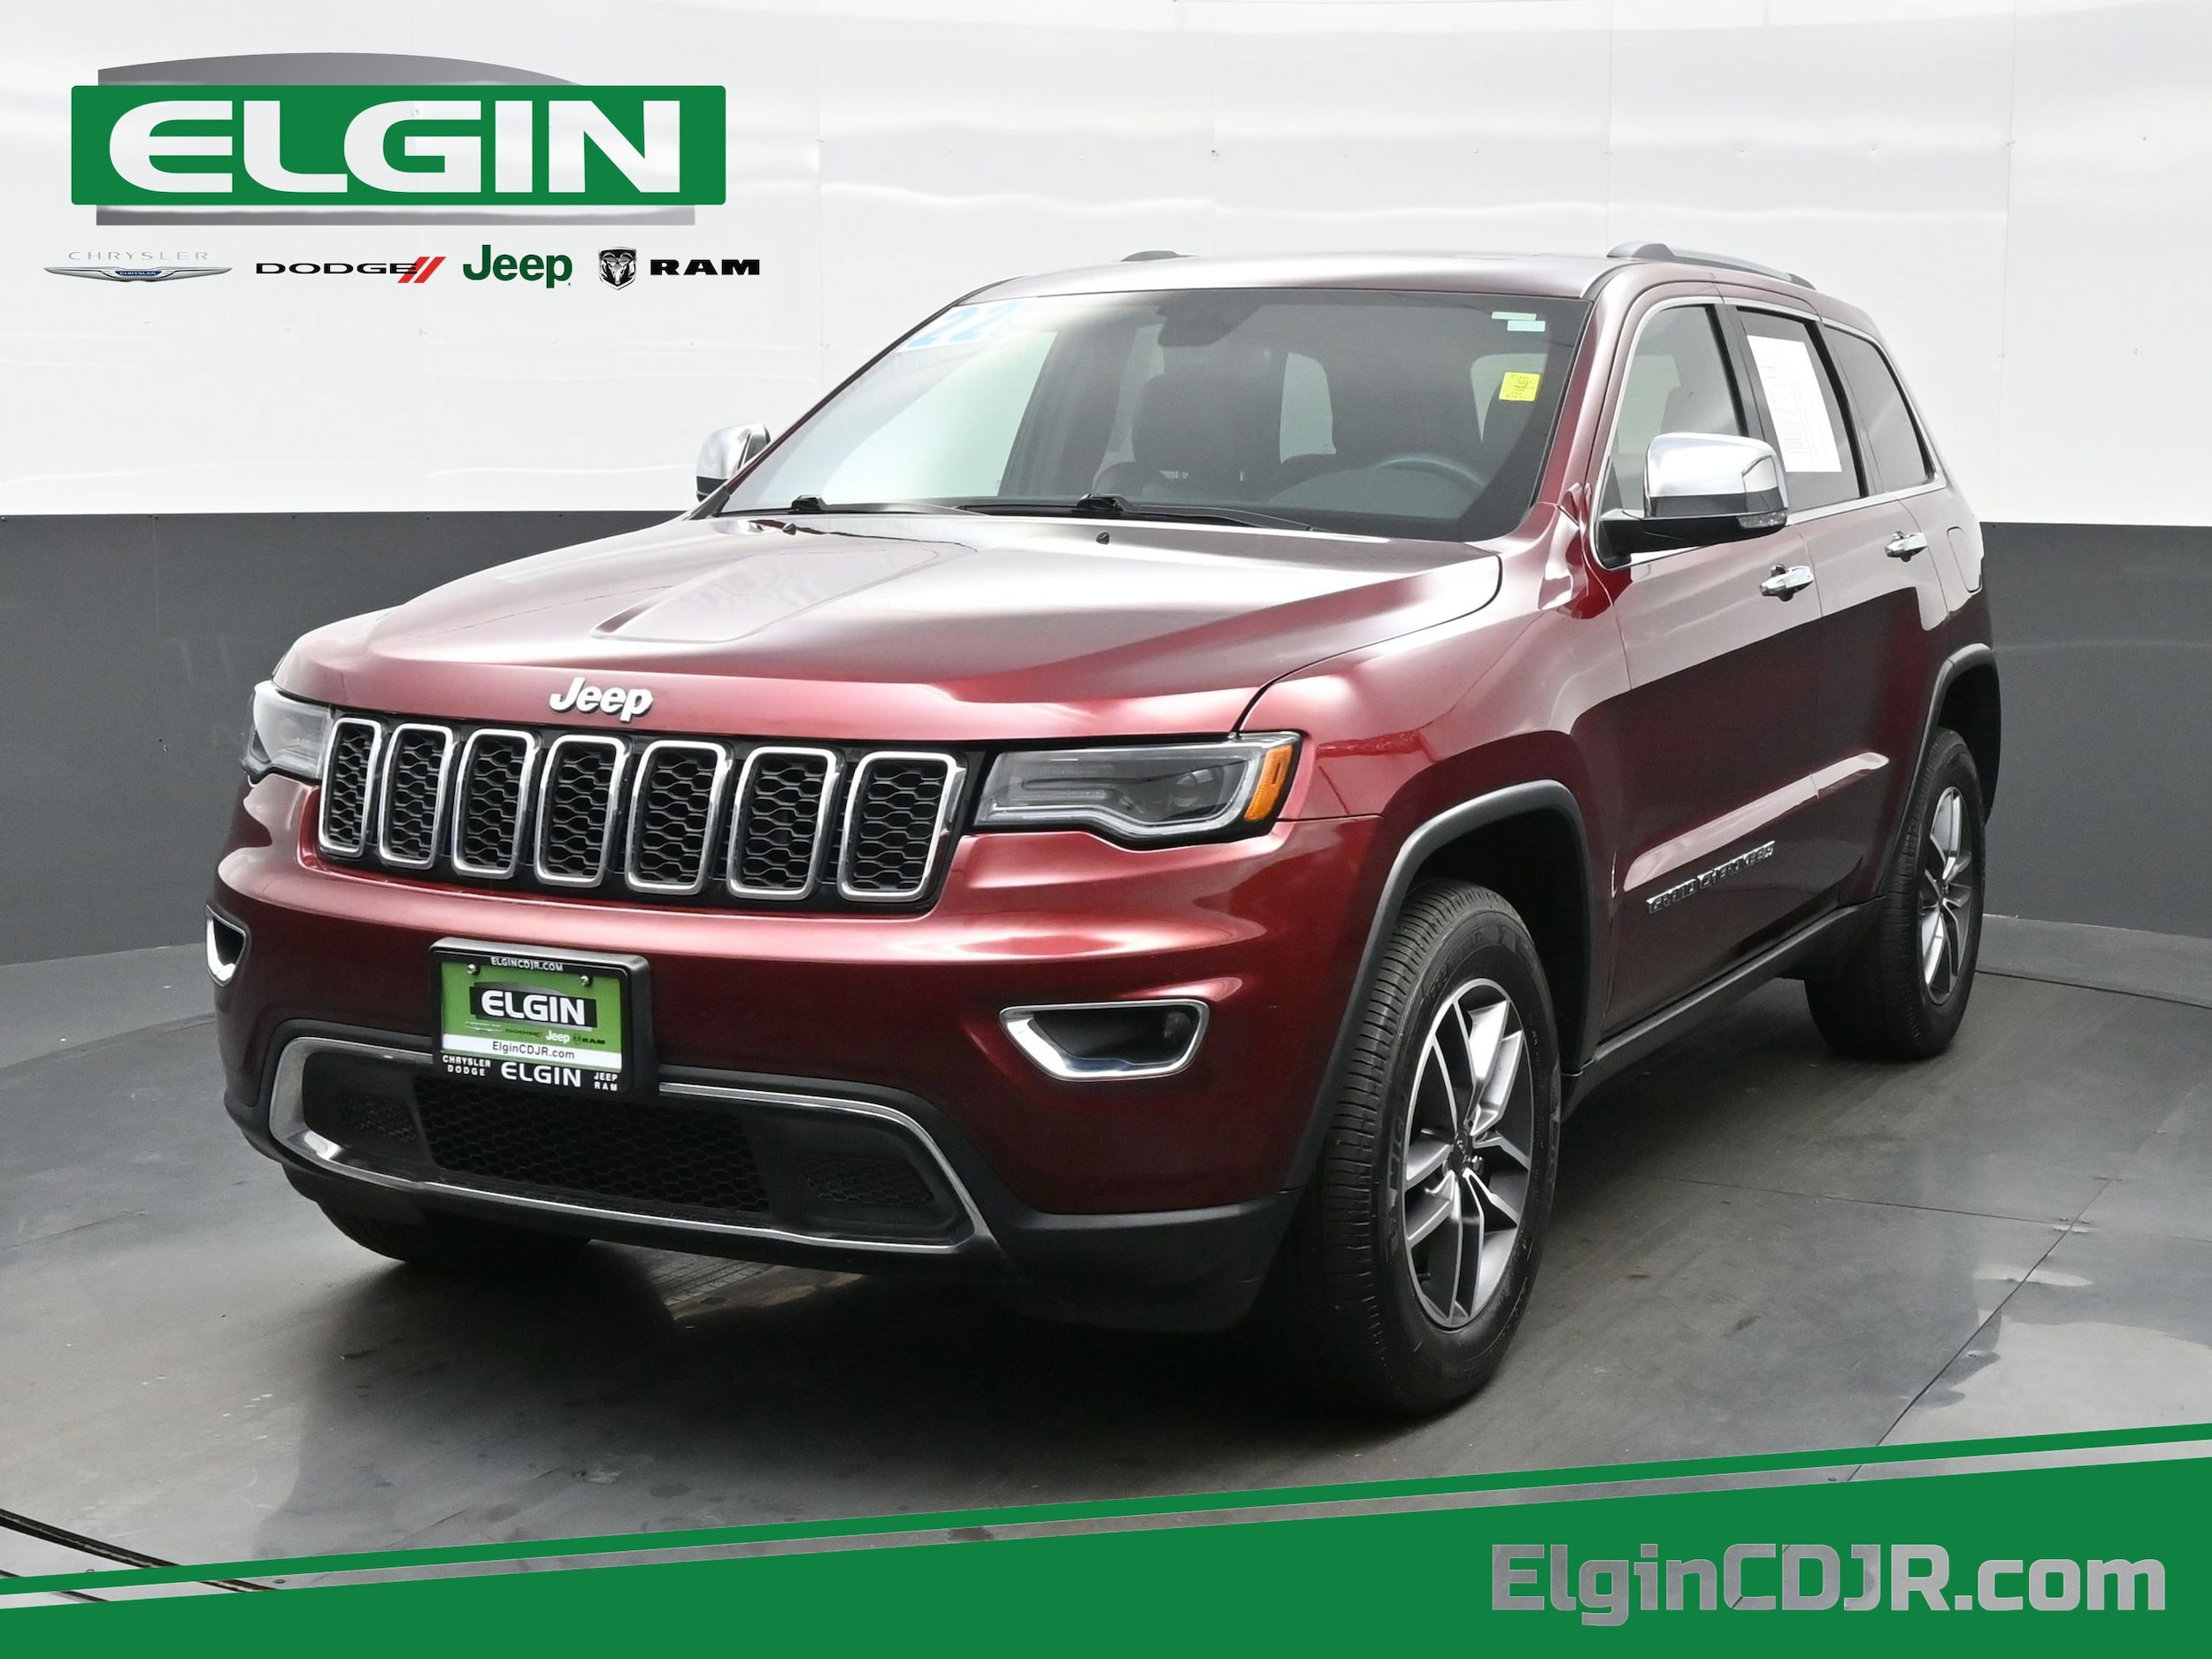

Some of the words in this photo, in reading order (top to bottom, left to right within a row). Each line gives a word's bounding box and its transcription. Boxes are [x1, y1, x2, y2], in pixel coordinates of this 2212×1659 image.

[549, 676, 654, 724] Jeep
[490, 956, 564, 972] ELGINCDJR.COM
[481, 990, 585, 1025] ELGIN
[545, 1030, 571, 1044] Jeep
[492, 1041, 575, 1059] ElginCDJR.com
[442, 1055, 491, 1068] CHRYSLER
[448, 1064, 486, 1077] DODGE
[501, 1061, 581, 1087] ELGIN
[594, 1071, 618, 1082] JEEP
[595, 1081, 618, 1091] RAM
